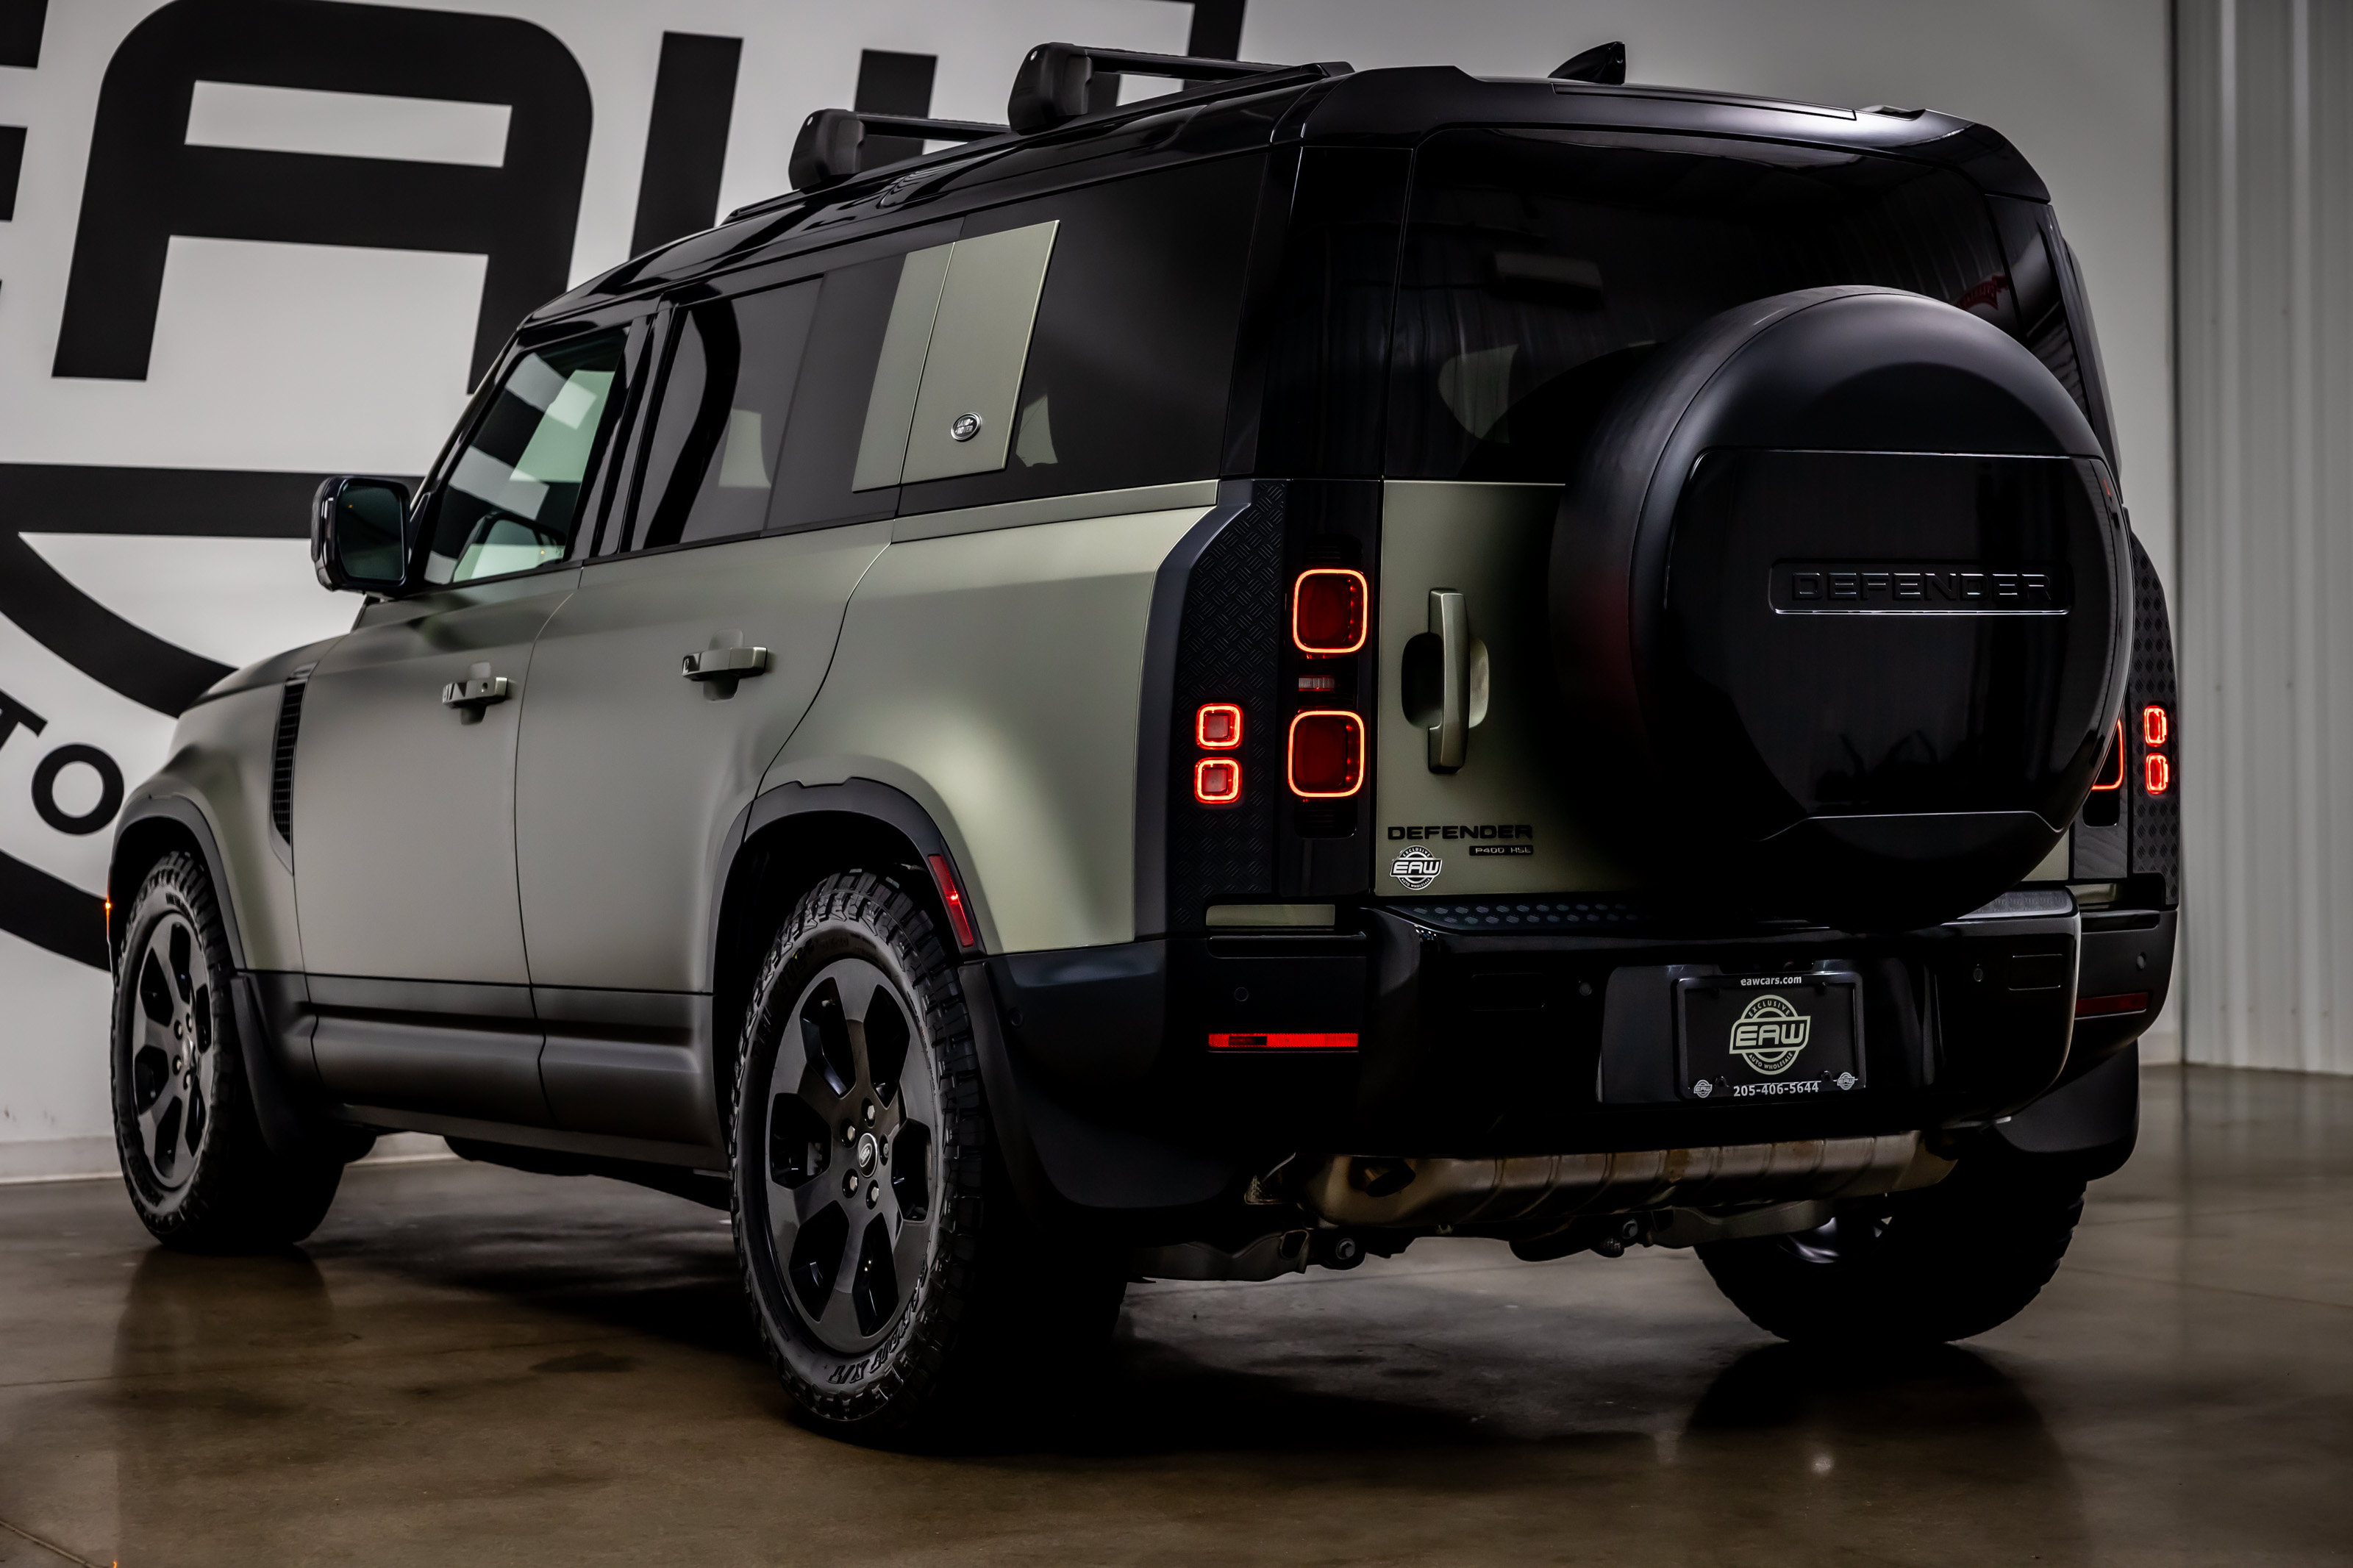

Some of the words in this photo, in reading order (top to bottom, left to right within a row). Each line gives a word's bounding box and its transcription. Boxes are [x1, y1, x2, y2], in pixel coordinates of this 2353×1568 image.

[1792, 572, 2052, 601] DEFENDER
[1388, 825, 1533, 840] DEFENDER
[1402, 847, 1431, 857] EXCLUSIVE
[1393, 862, 1439, 874] EAW
[1402, 878, 1410, 887] AUTO
[1410, 878, 1431, 888] WHOLESALE
[1740, 976, 1802, 987] eawcars.com
[1748, 1000, 1790, 1017] EXCLUSIVE
[1735, 1023, 1805, 1047] EAW
[1748, 1053, 1763, 1067] AUTO
[1763, 1052, 1794, 1070] WHOLESALE
[1733, 1081, 1819, 1098] 205-406-5644
